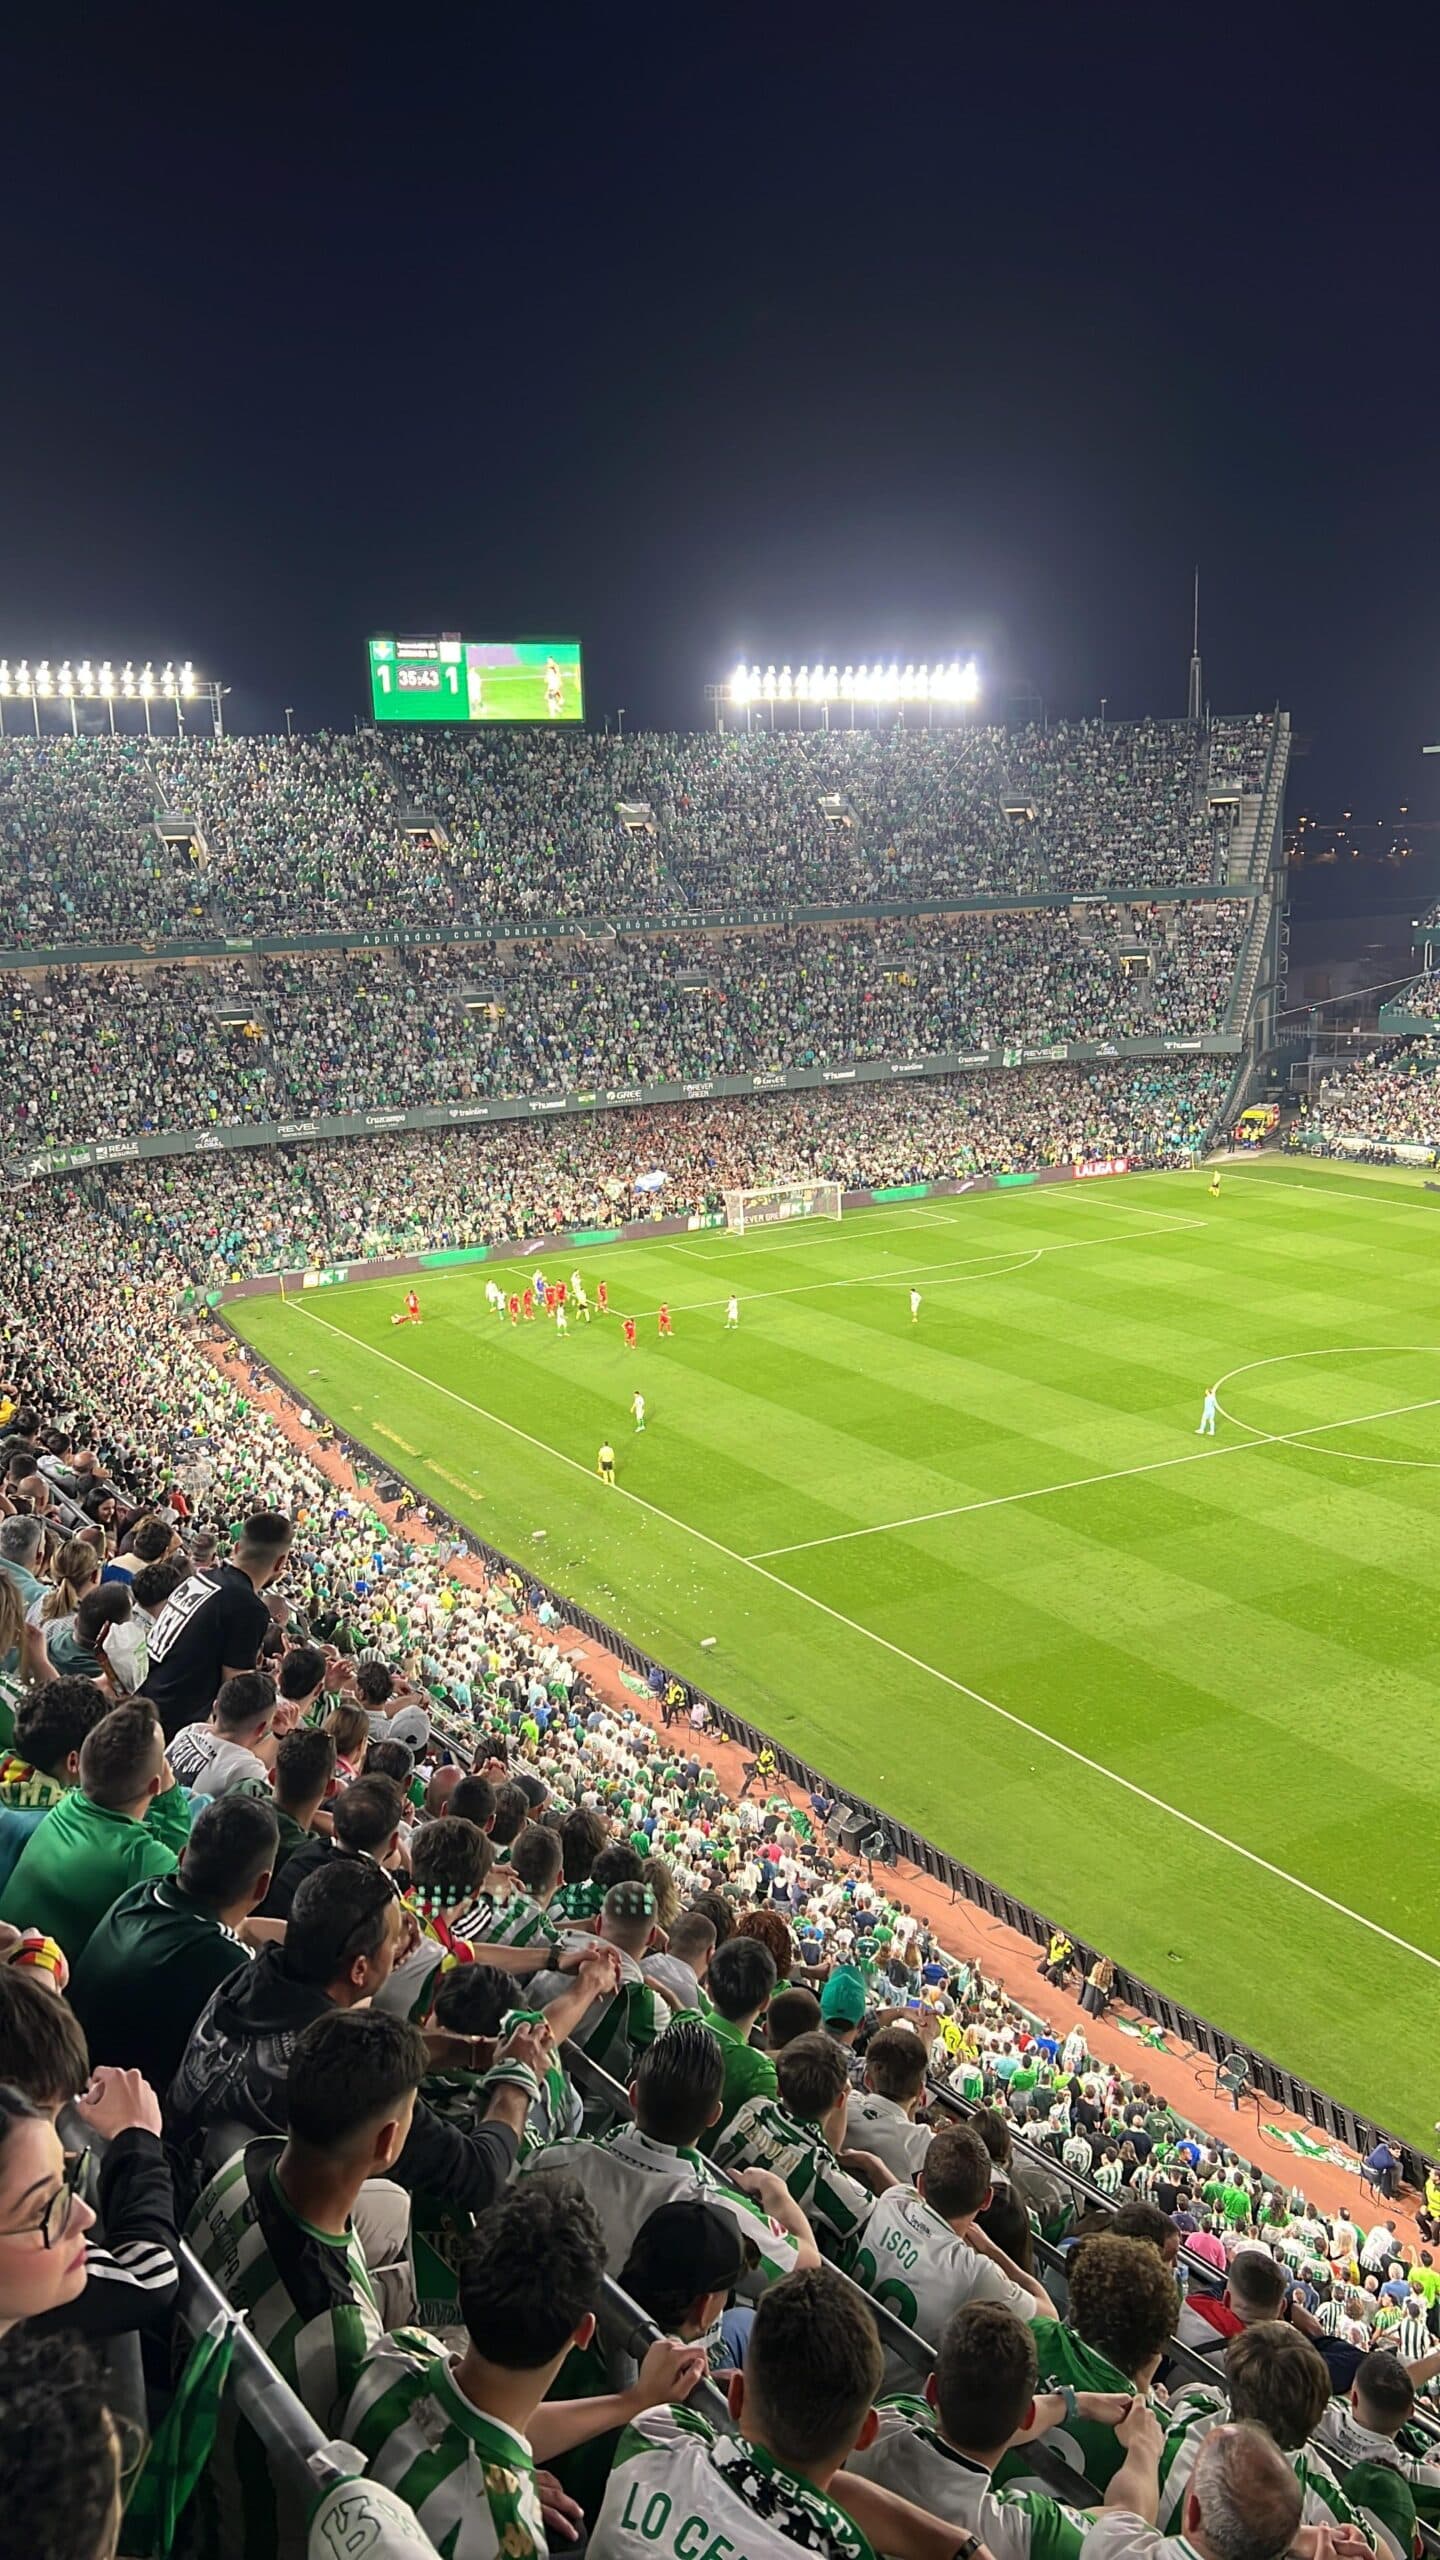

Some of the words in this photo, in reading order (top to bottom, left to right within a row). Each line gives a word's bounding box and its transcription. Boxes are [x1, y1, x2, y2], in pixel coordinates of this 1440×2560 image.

[376, 665, 391, 694] 1
[398, 670, 439, 686] 35:43
[445, 666, 459, 694] 1
[363, 932, 441, 944] Apiñados
[454, 930, 492, 939] como
[504, 926, 547, 936] balas
[559, 924, 575, 934] de
[661, 917, 706, 928] Somos
[720, 914, 741, 924] del
[753, 912, 793, 922] BETIS
[277, 1122, 320, 1134] REVEL
[108, 1142, 138, 1153] REALE
[1075, 1161, 1112, 1178] LALIGA
[880, 2226, 919, 2270] ISCO
[621, 2481, 672, 2541] LO
[673, 2515, 748, 2560] CE
